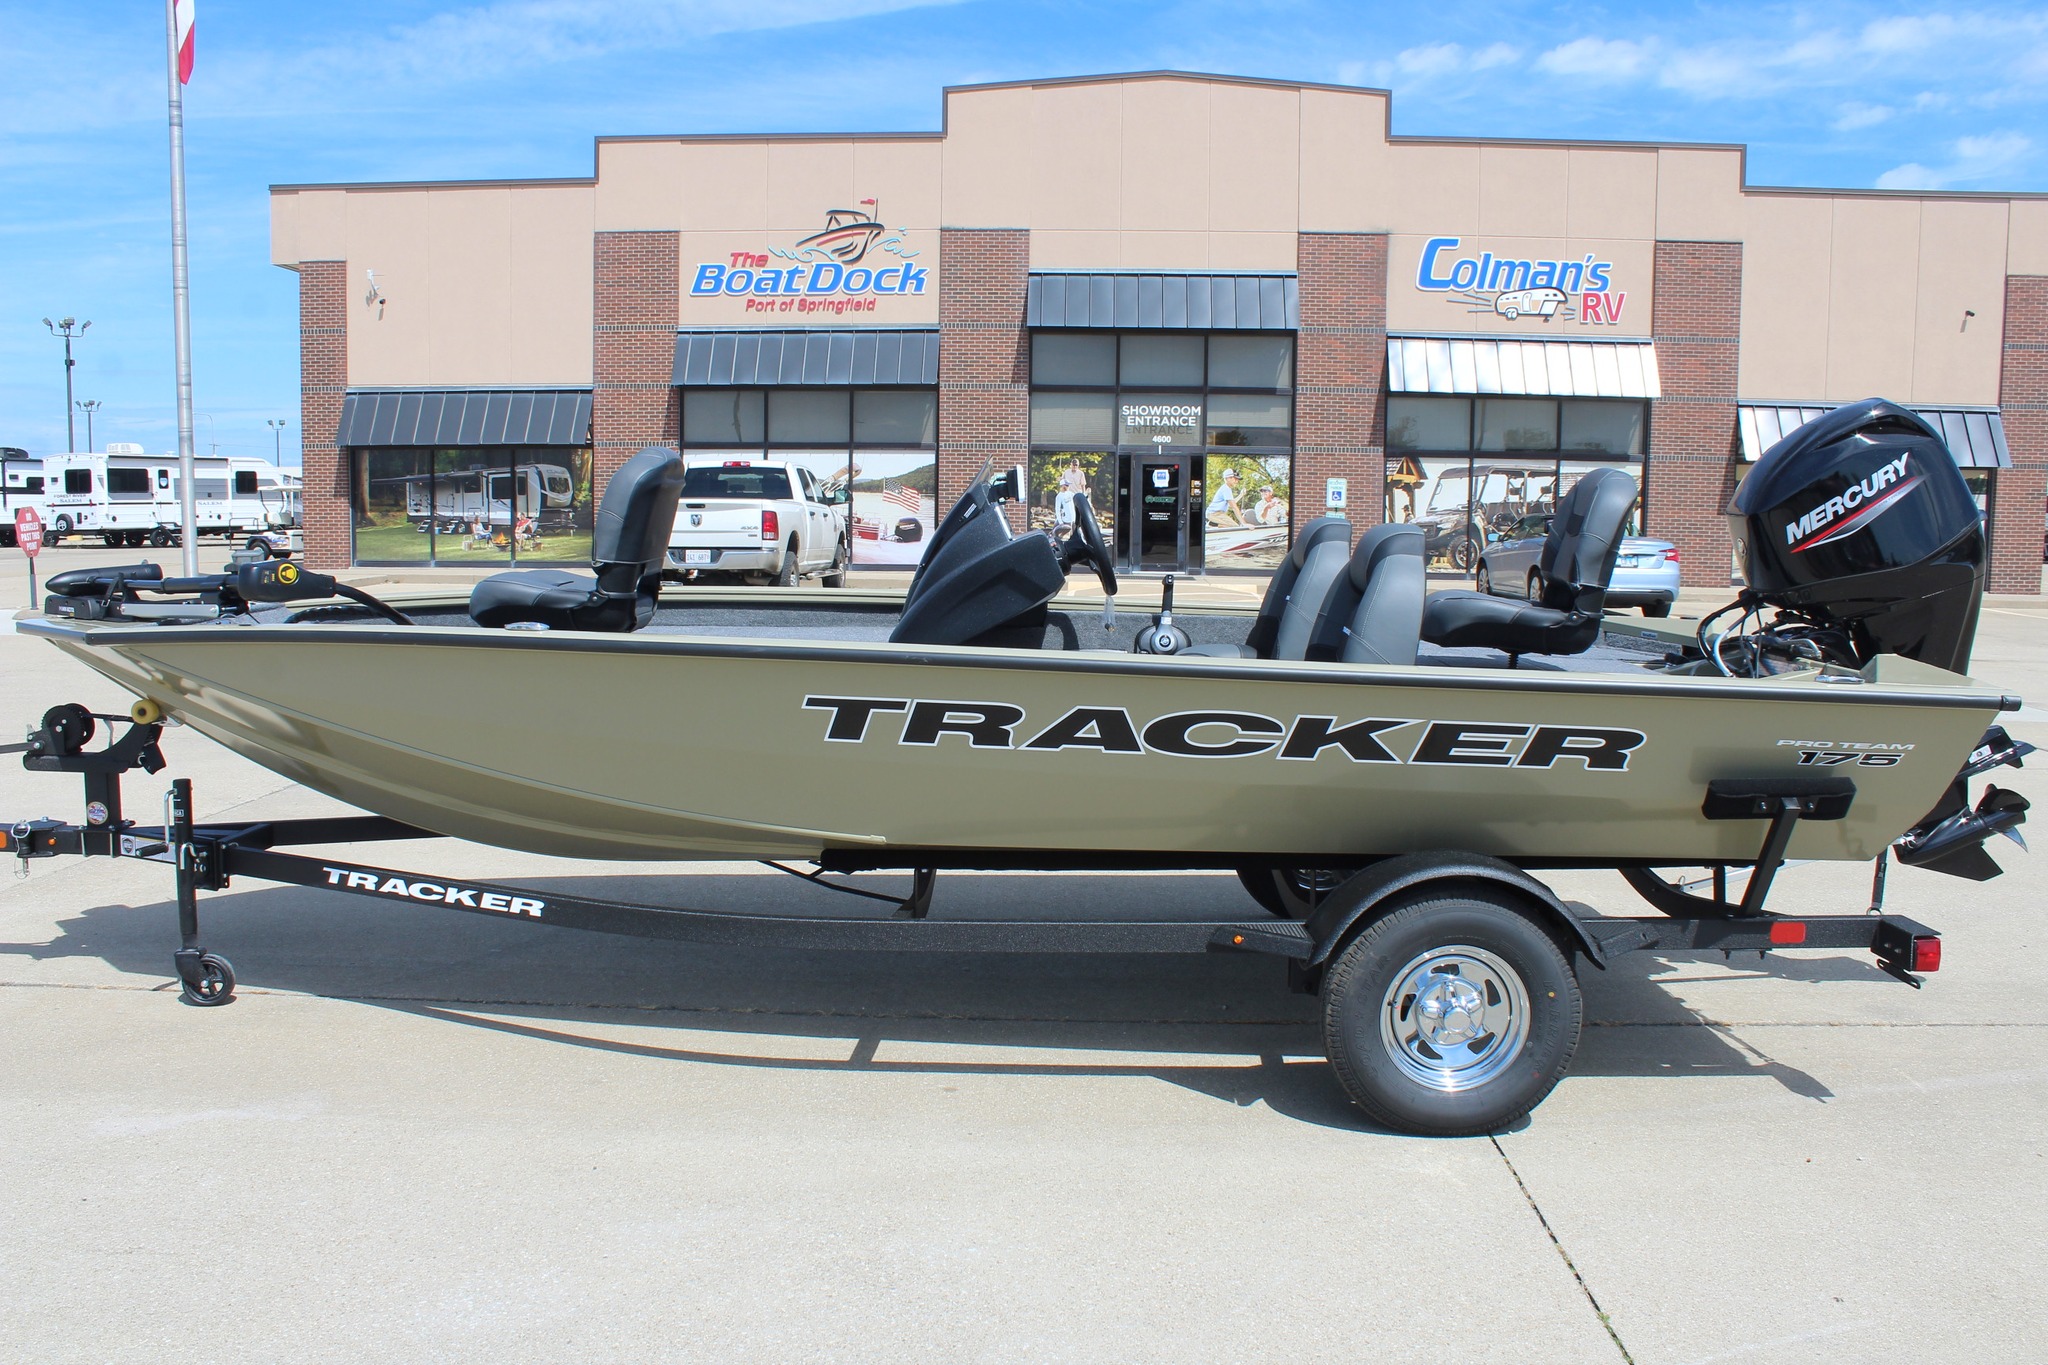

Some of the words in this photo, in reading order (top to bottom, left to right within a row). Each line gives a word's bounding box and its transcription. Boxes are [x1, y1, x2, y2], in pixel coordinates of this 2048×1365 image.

[730, 252, 769, 268] The
[1415, 237, 1613, 295] Colman's
[745, 298, 776, 313] Port
[779, 298, 795, 312] of
[797, 298, 877, 315] Springfield
[1580, 292, 1627, 324] RV
[1122, 405, 1201, 416] SHOWROOM
[1127, 416, 1197, 426] ENTRANCE
[1152, 435, 1172, 443] 4600
[1786, 451, 1911, 545] MERCURY
[801, 694, 1647, 771] TRACKER
[1776, 739, 1834, 748] PRO
[1838, 742, 1916, 751] TEAM
[1797, 750, 1905, 768] 175
[322, 866, 545, 917] TRACKER
